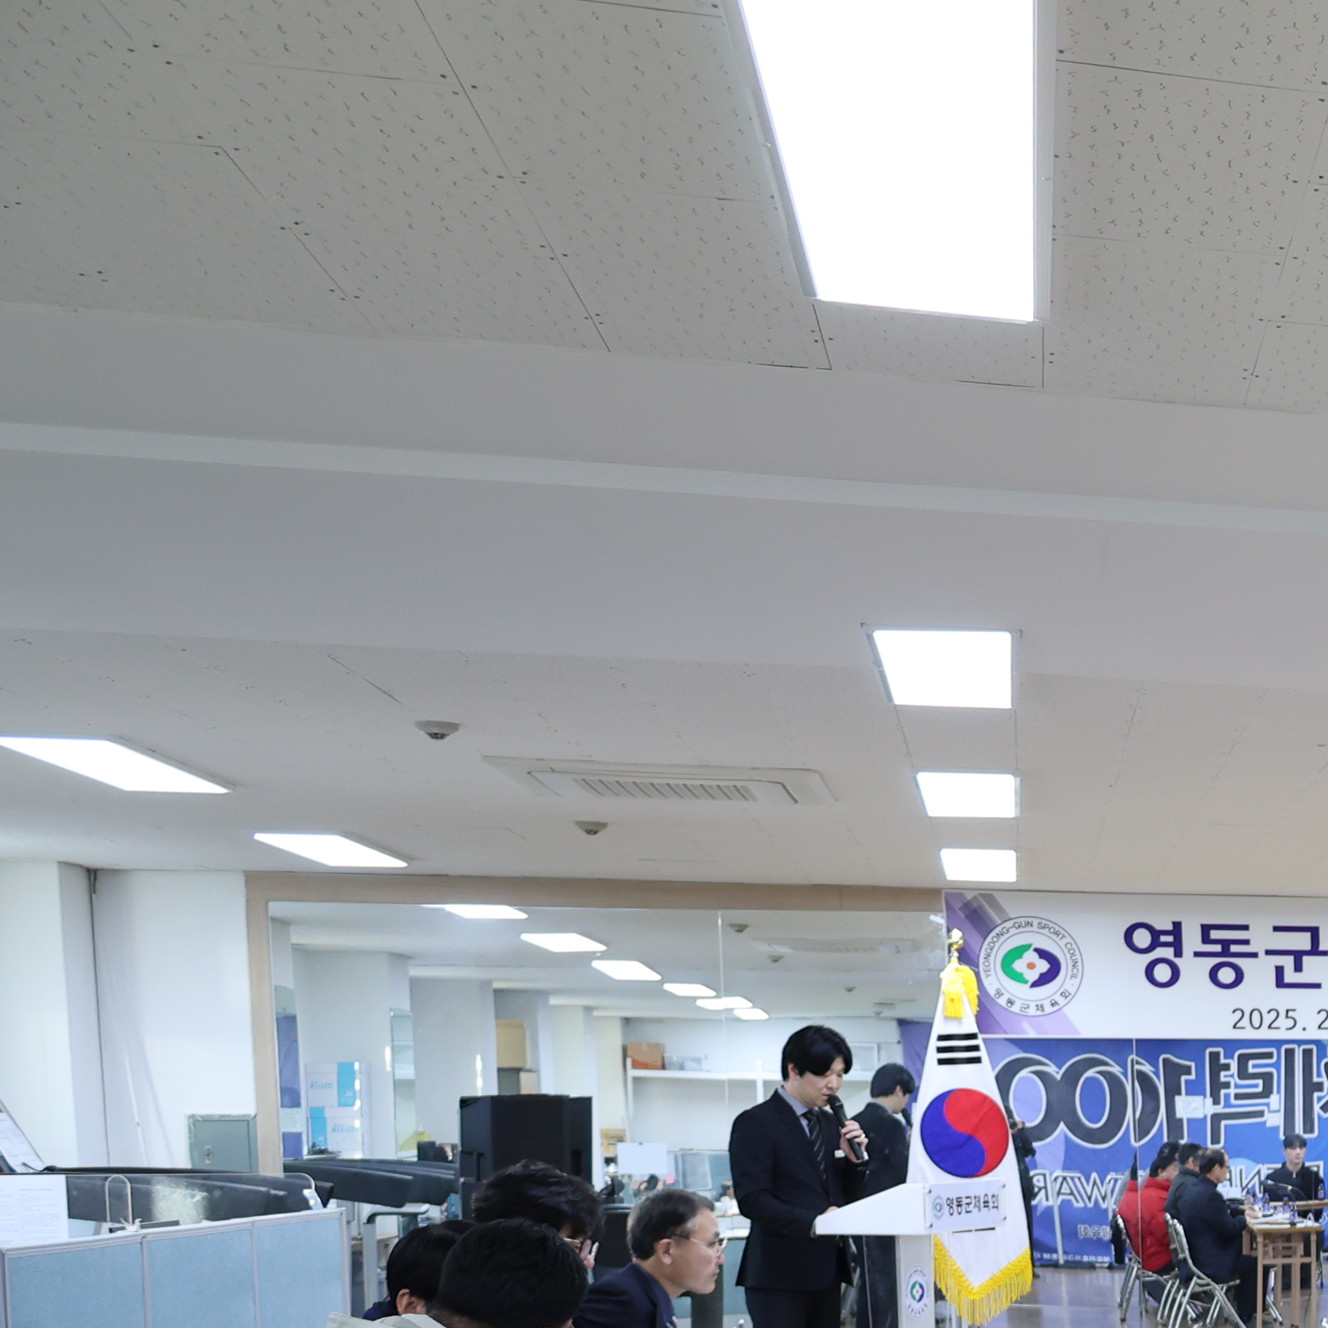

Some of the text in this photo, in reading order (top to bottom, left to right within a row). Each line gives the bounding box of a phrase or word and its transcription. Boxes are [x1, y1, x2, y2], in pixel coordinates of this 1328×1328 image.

[982, 920, 1080, 981] YEONGDONG-GUN SPORT COUNCIL
[994, 987, 1072, 1013] 영동군체육회
[1231, 1007, 1307, 1032] 2025.
